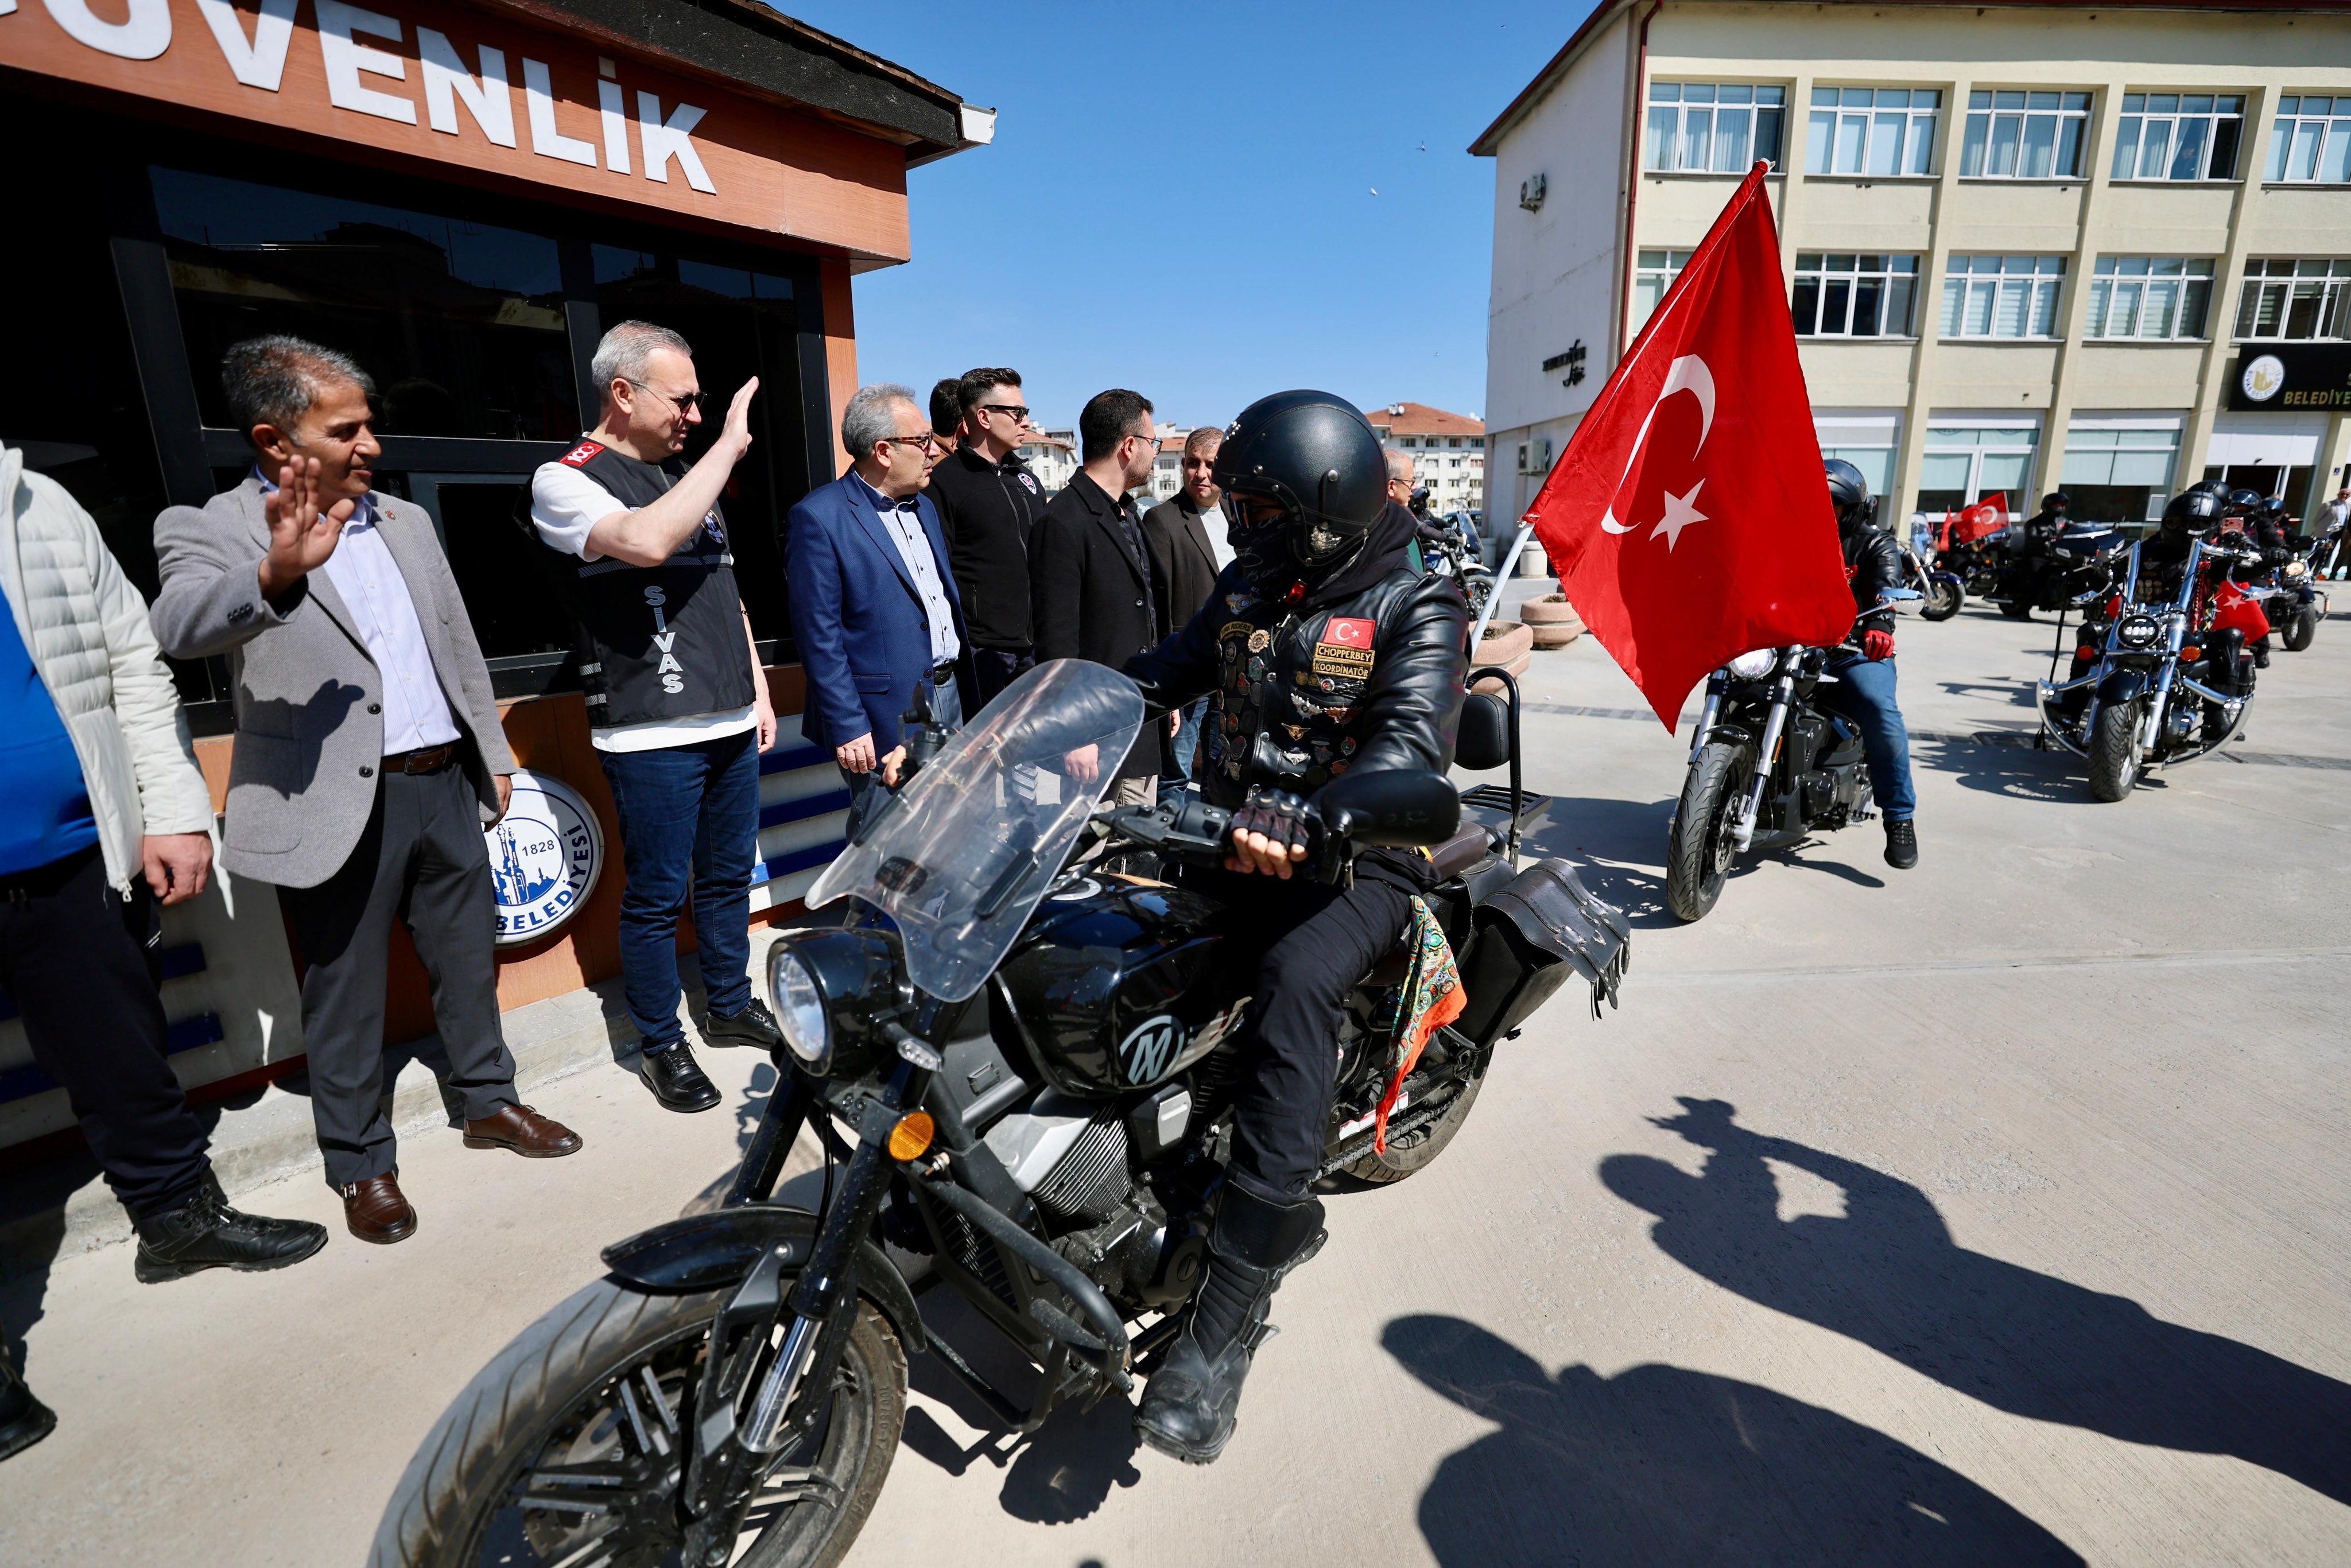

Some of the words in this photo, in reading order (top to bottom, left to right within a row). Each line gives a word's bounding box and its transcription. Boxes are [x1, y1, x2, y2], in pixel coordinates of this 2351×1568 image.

[0, 0, 717, 196] VENLİK
[1231, 623, 1251, 631] RIDERS
[1318, 646, 1372, 662] CHOPPERBEY
[1315, 663, 1368, 677] KOORDİNATÖR
[521, 840, 555, 857] 1828
[496, 824, 589, 930] BELEDİYESİ
